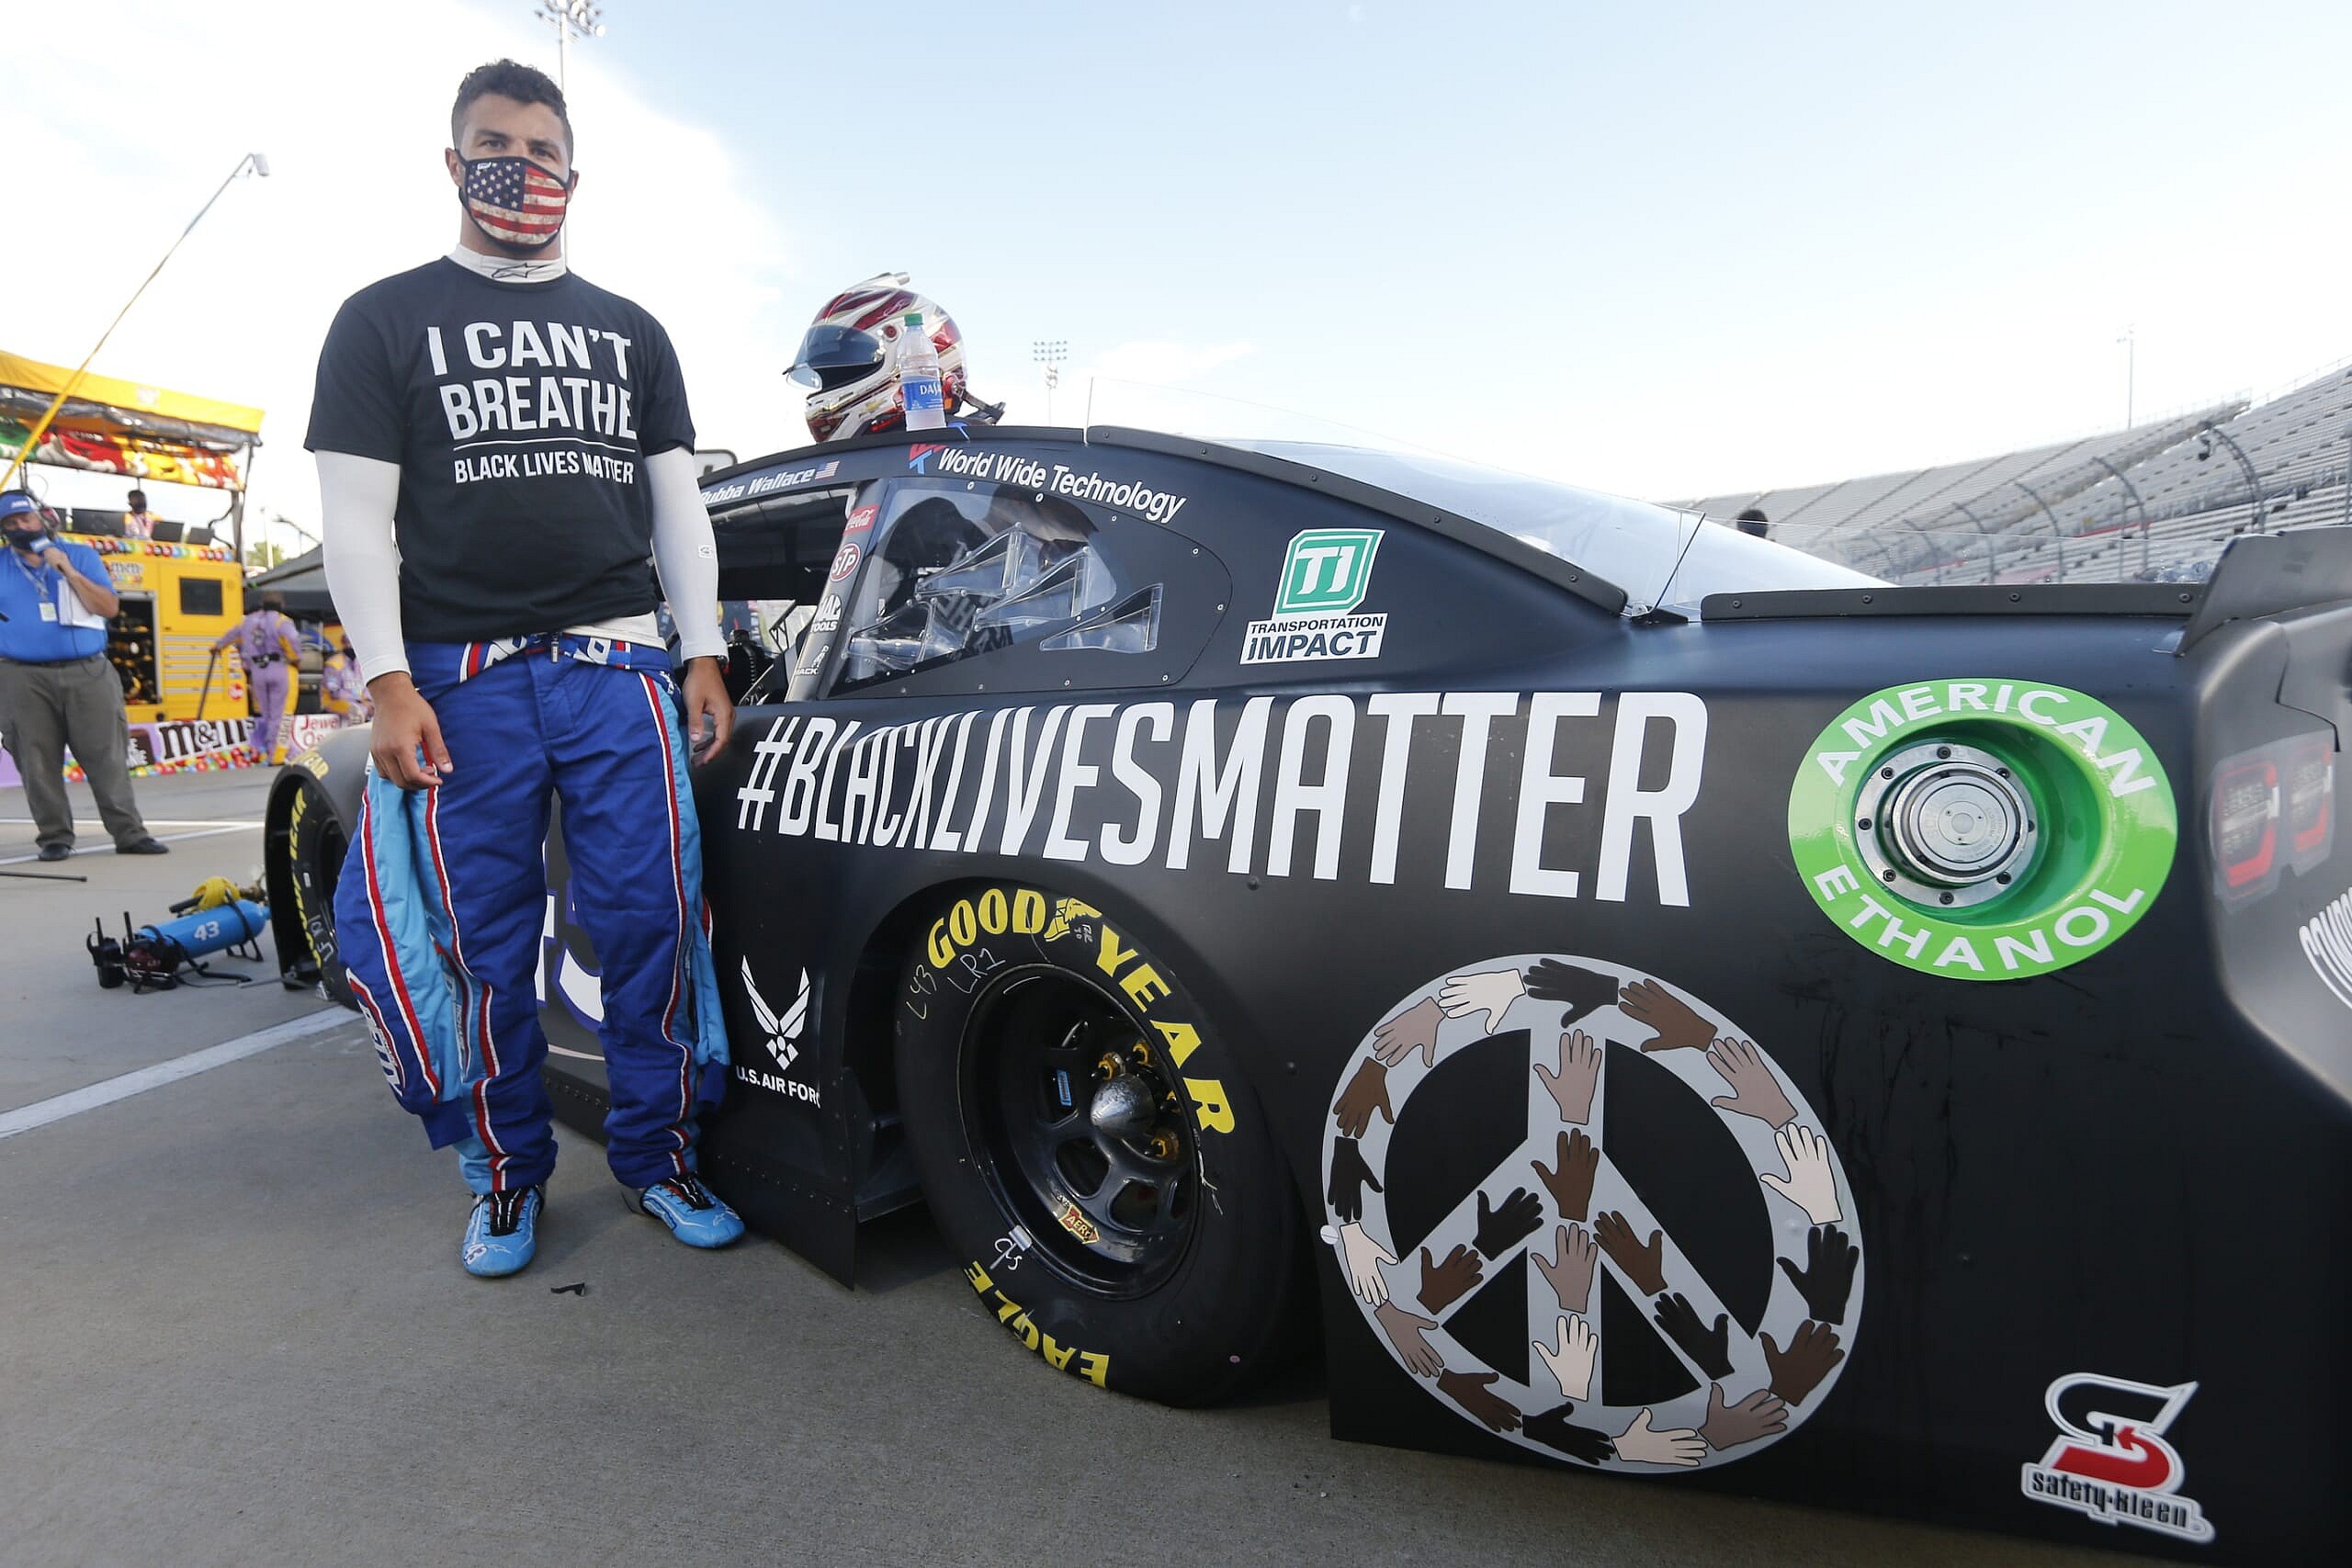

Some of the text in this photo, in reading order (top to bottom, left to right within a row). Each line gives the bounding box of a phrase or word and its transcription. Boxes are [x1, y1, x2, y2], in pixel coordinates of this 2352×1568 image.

[427, 321, 632, 380] I CAN'T
[438, 376, 638, 440] BREATHE
[454, 452, 635, 484] BLACK LIVES MATTER
[748, 468, 816, 495] Wallace
[937, 447, 1187, 525] World Wide Technology
[831, 547, 856, 576] STP
[1250, 616, 1384, 634] TRANSPORTATION
[301, 715, 340, 730] Jewe
[1815, 682, 2157, 798] AMERICAN
[737, 691, 1708, 908] #BLACKLIVESMATTER
[193, 920, 220, 941] 43
[1815, 863, 2146, 974] ETHANOL
[927, 887, 1236, 1134] GOOD YEAR
[736, 1066, 761, 1085] U.S.
[762, 1073, 786, 1094] AIR
[962, 1260, 1110, 1389] EAGLE
